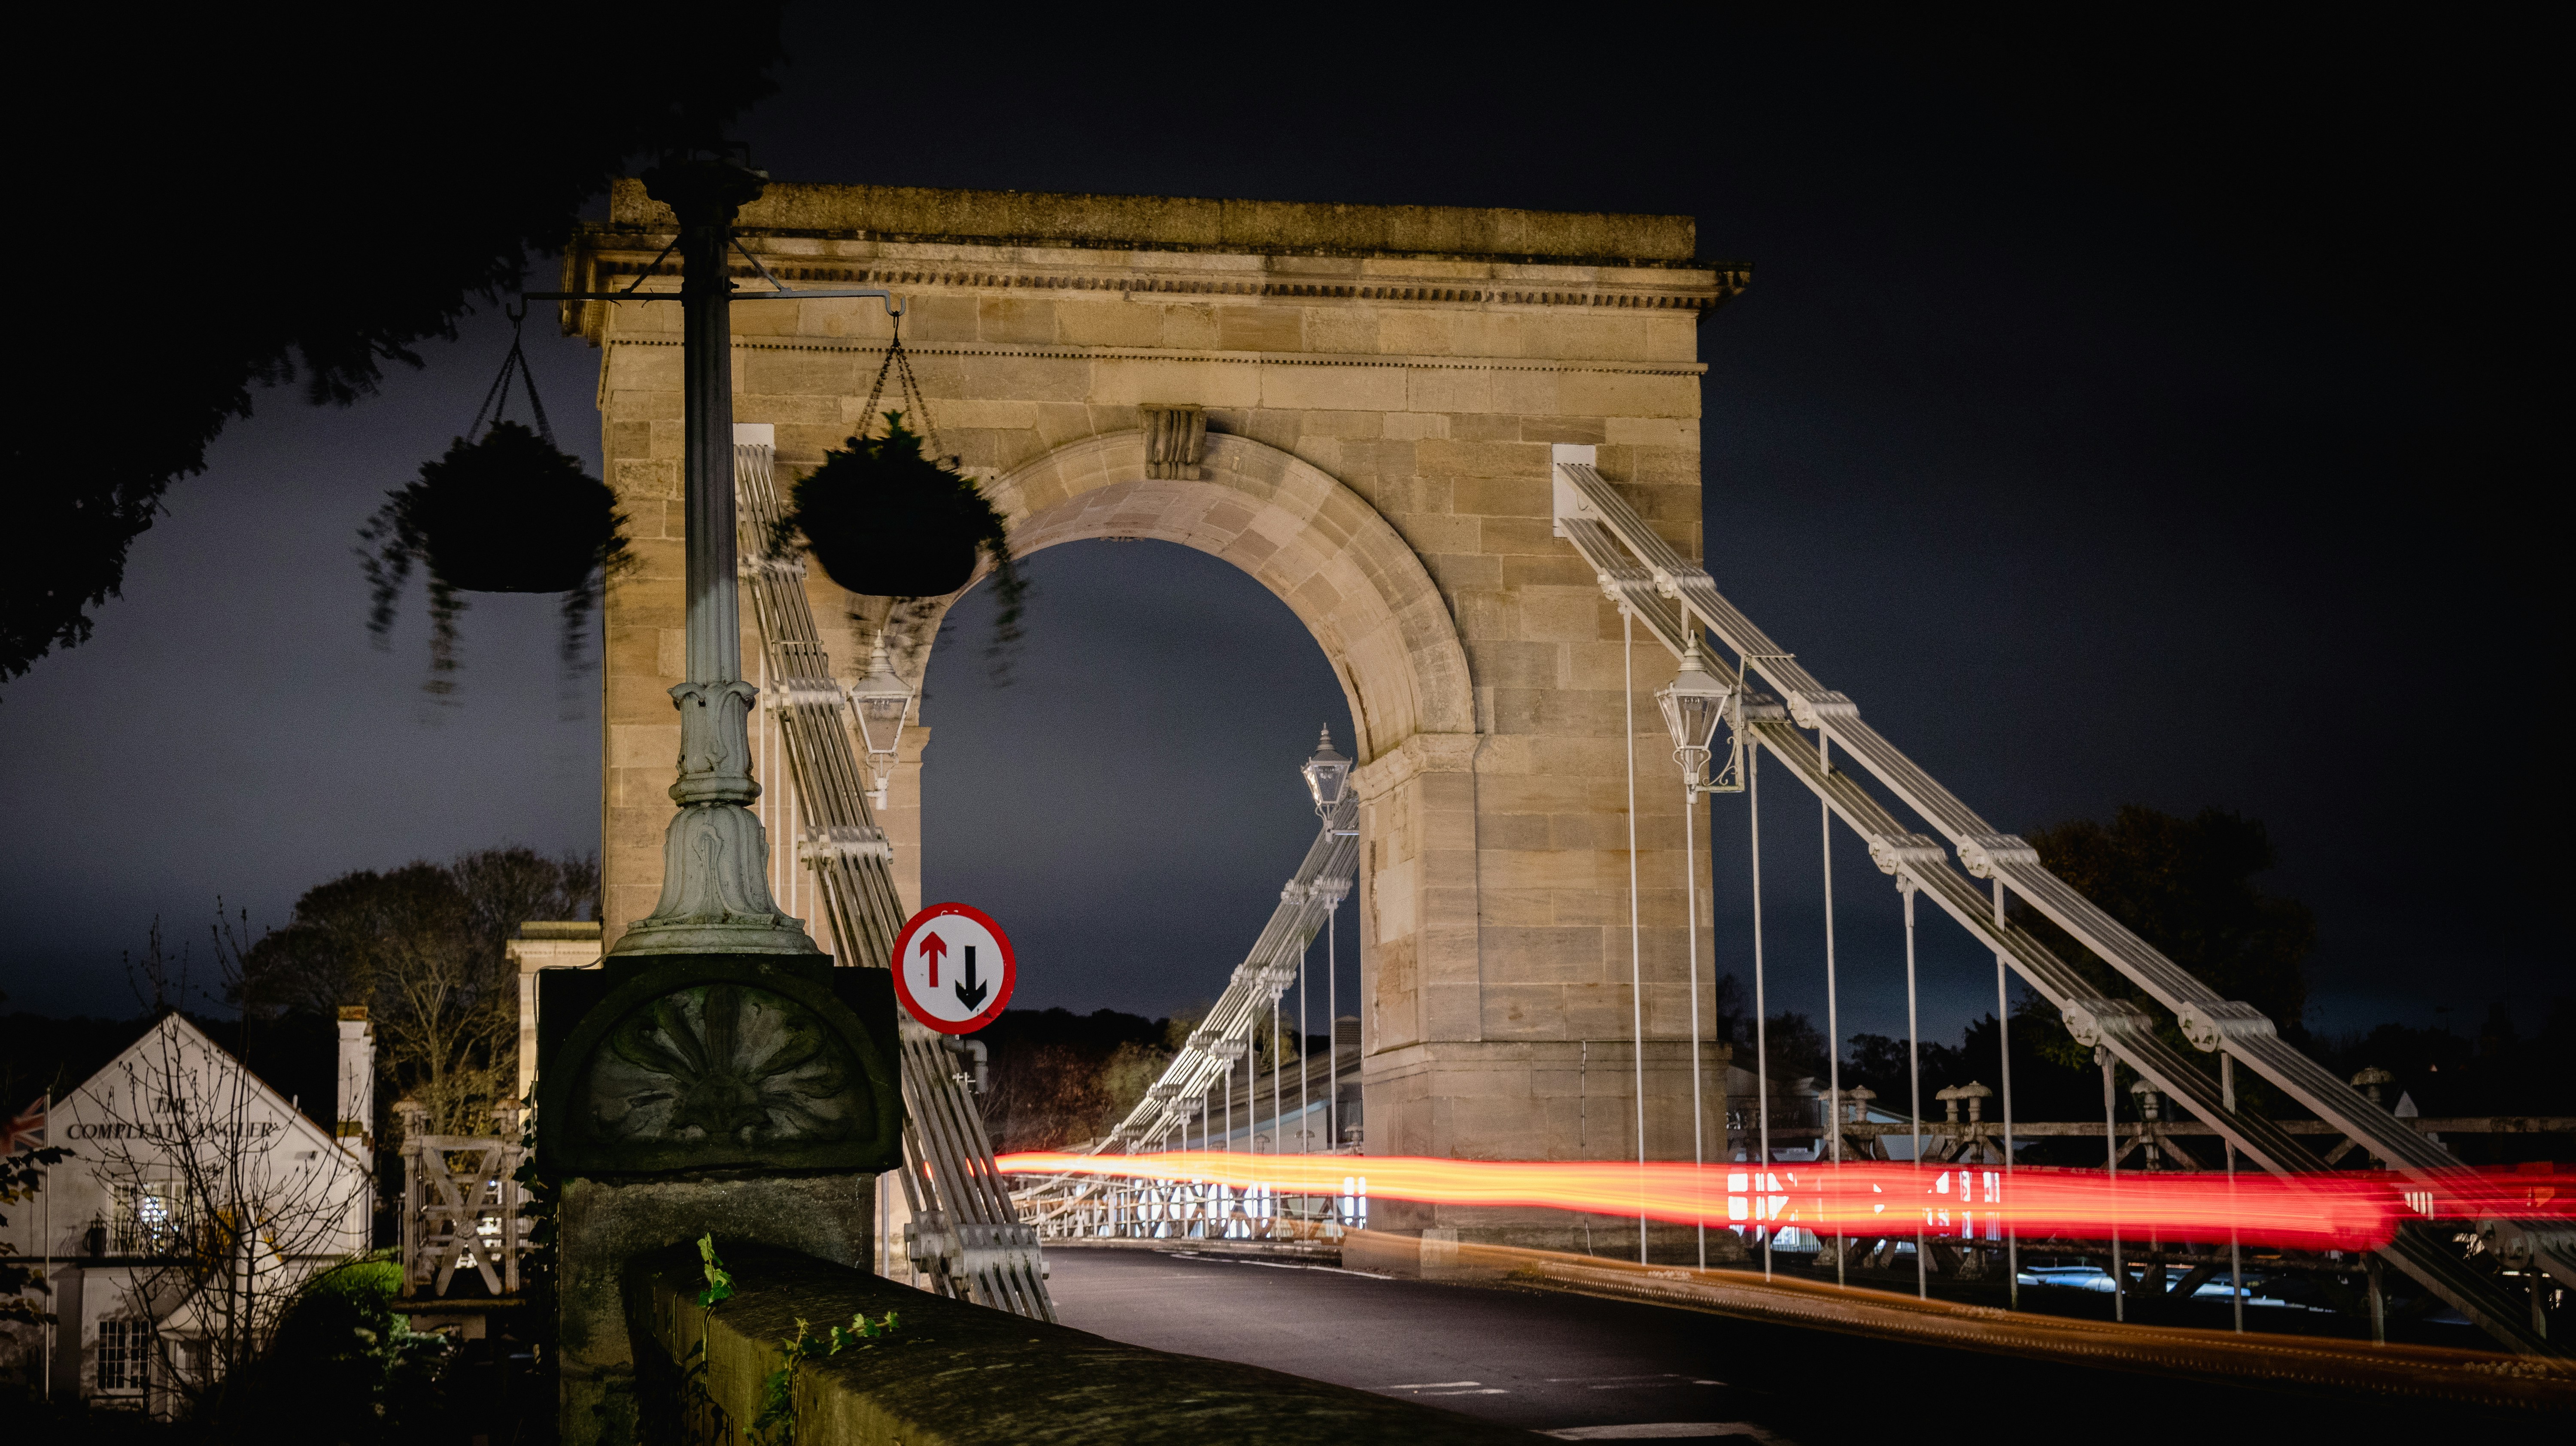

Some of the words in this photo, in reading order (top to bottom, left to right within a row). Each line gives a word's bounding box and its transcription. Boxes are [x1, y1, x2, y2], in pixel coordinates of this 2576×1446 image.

[154, 1097, 192, 1113] THE
[67, 1122, 177, 1139] COMPLEAT
[194, 1121, 271, 1138] ANGLER
